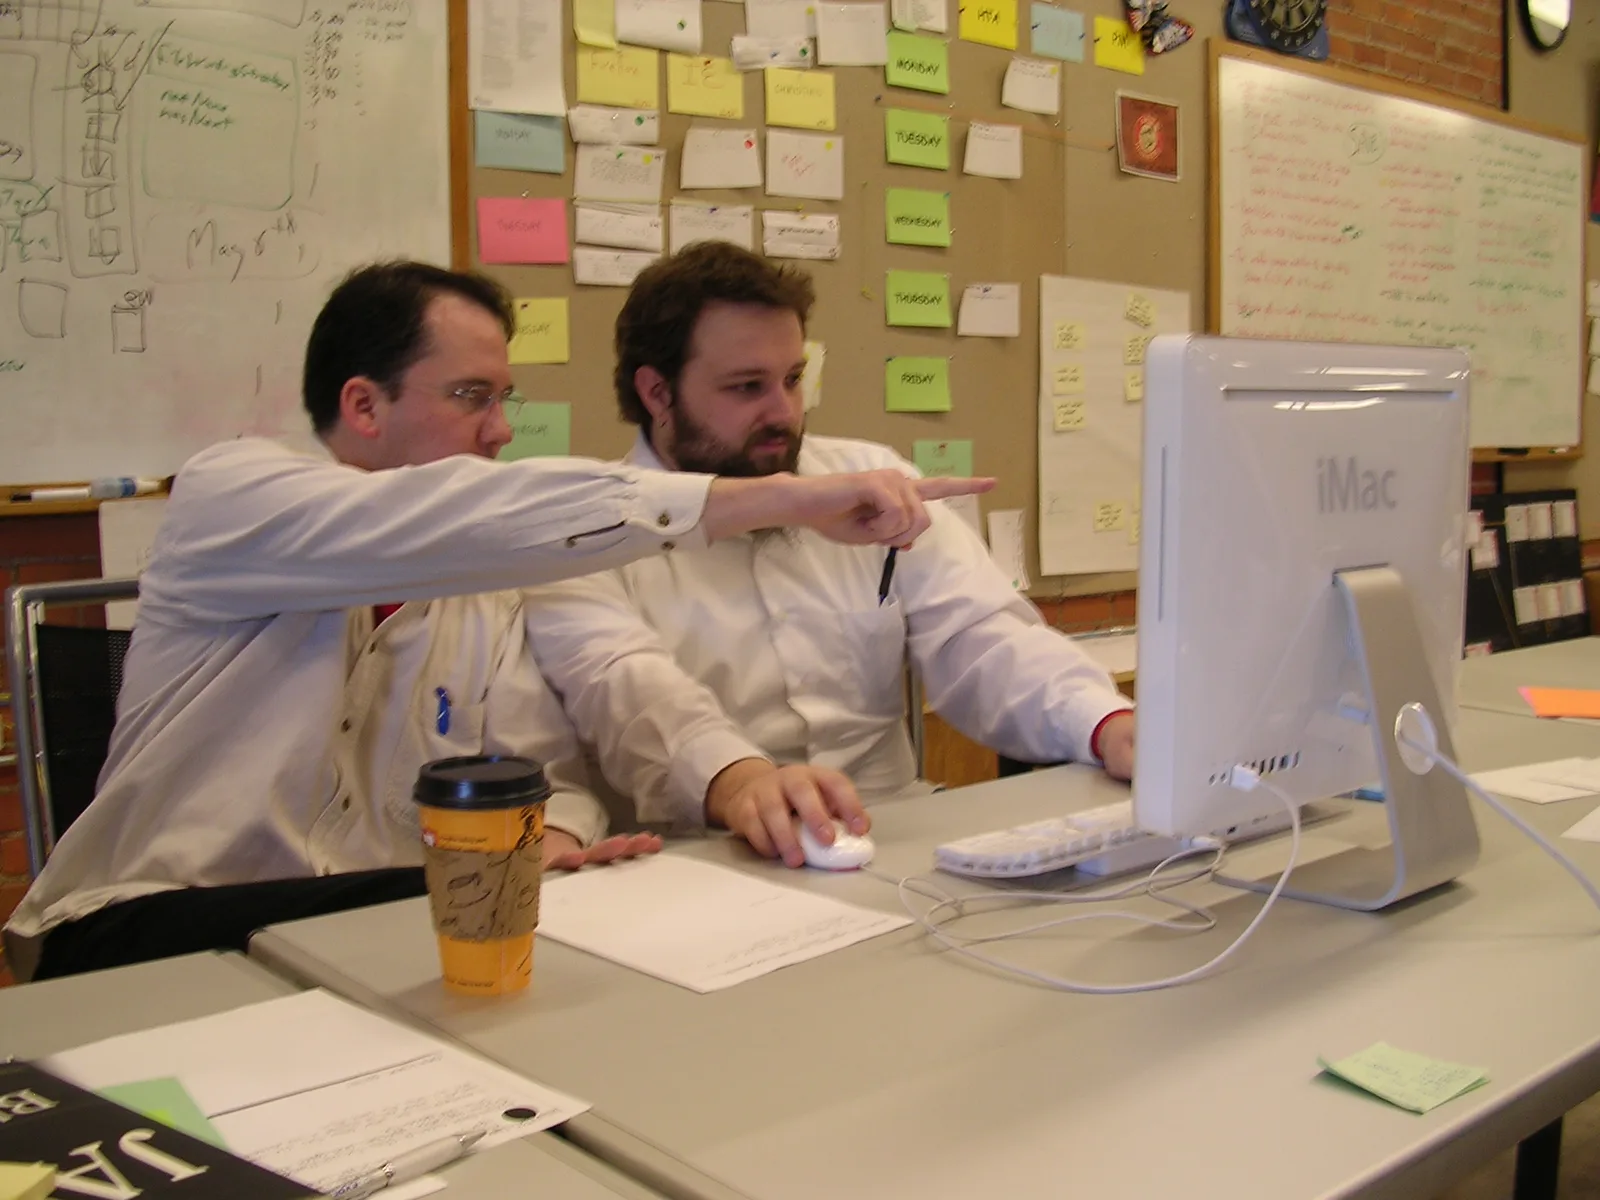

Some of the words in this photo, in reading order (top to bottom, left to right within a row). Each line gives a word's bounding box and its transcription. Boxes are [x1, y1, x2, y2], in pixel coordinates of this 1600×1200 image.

[895, 57, 940, 76] MONDAY
[894, 130, 943, 148] TUESDAY
[893, 214, 943, 229] WEDNESDAY
[894, 292, 943, 306] THURSDAY
[900, 371, 936, 387] FRIDAY
[1315, 454, 1399, 514] iMac
